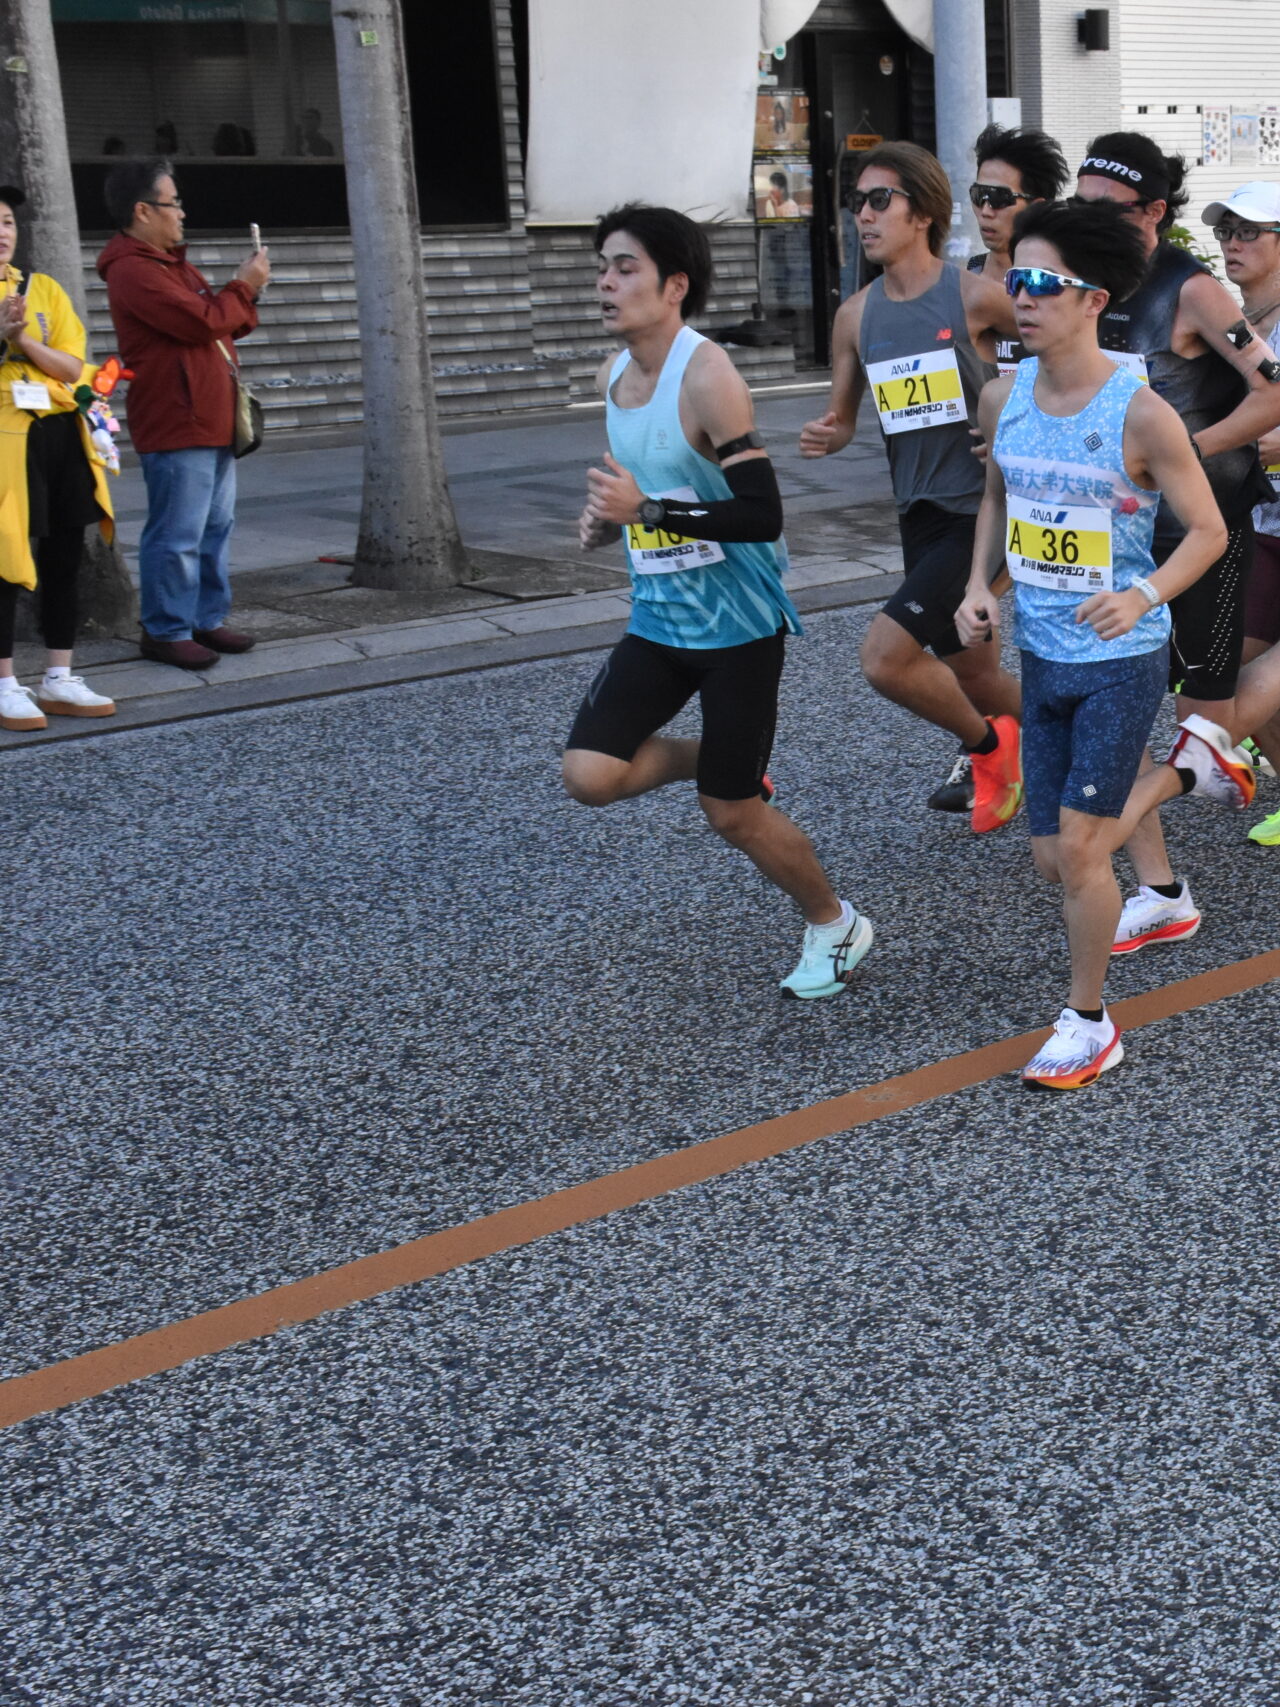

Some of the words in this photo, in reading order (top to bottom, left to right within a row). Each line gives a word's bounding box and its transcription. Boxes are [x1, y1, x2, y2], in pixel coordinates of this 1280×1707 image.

[1082, 157, 1142, 181] reme
[891, 362, 912, 375] ANA
[879, 384, 891, 413] A
[904, 374, 932, 407] 21
[1030, 508, 1053, 523] ANA
[1008, 521, 1022, 555] A
[1041, 528, 1079, 564] 36
